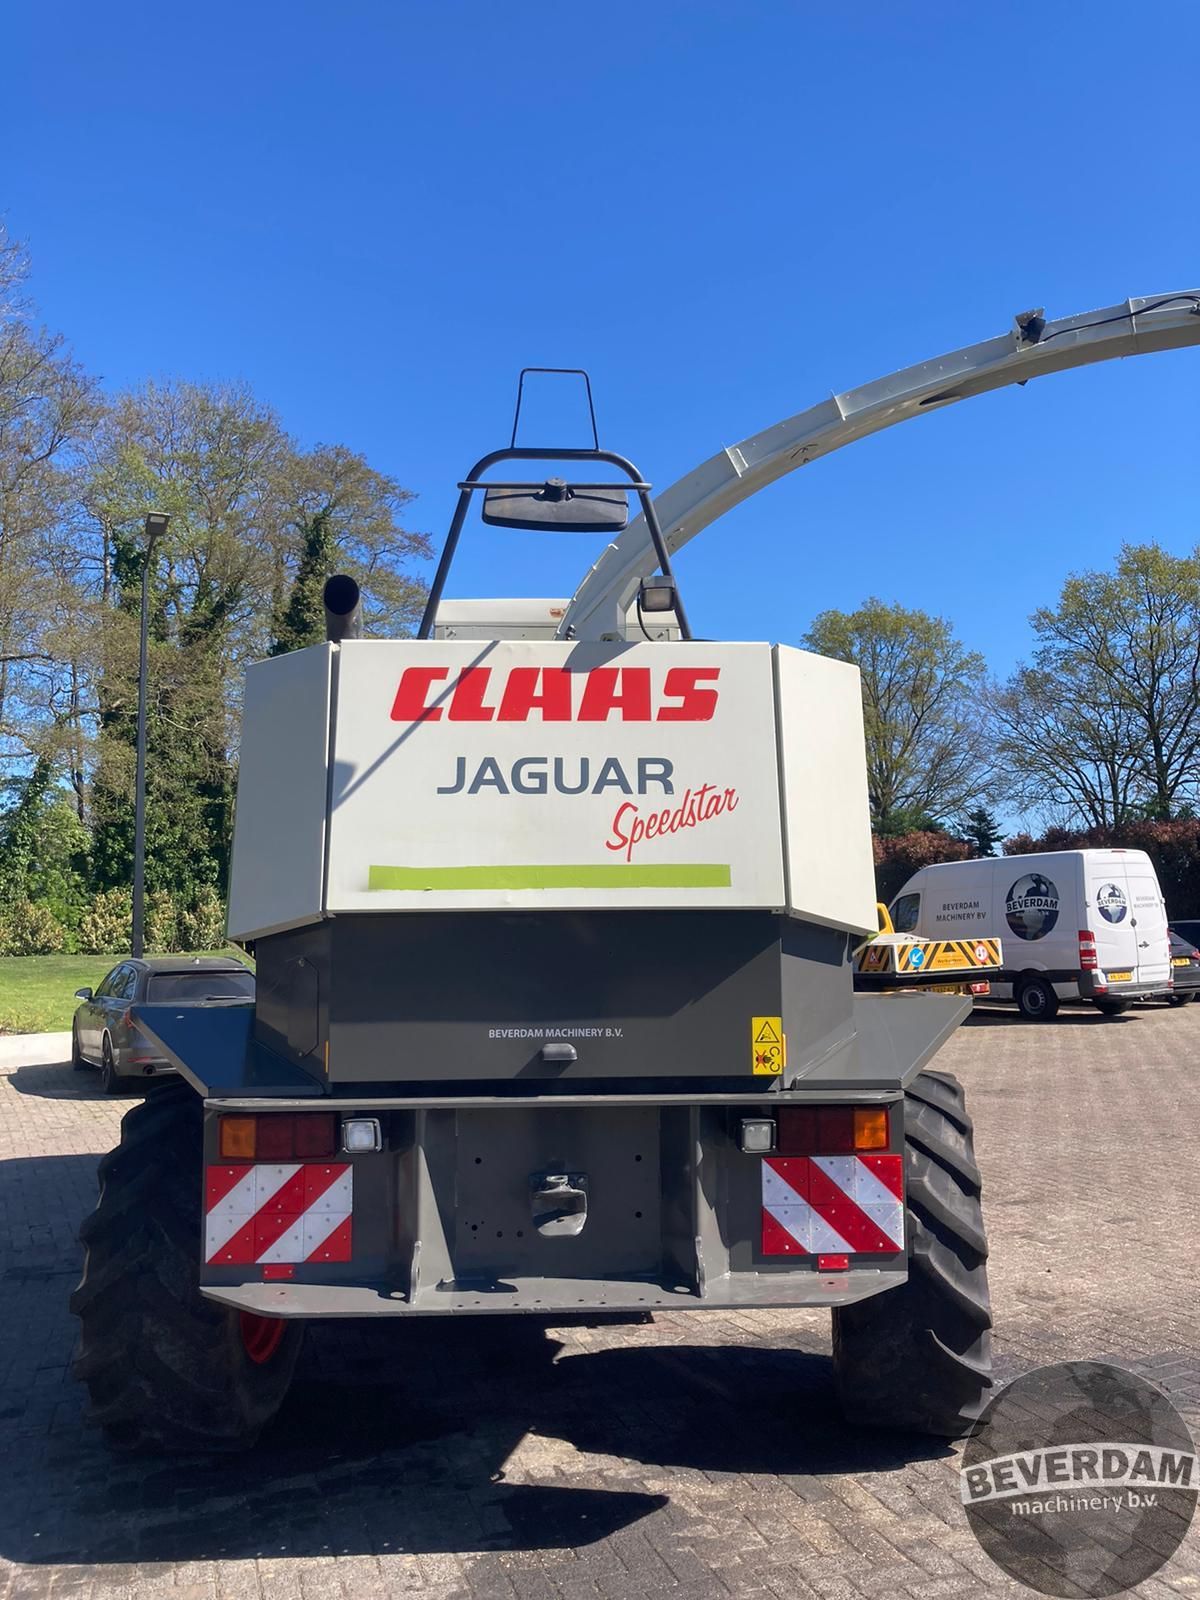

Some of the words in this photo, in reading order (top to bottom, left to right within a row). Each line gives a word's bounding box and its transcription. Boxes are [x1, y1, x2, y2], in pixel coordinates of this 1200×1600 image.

[390, 667, 721, 722] CLAAS
[437, 756, 675, 795] JAGUAR
[605, 783, 739, 863] Speedstar
[942, 901, 980, 911] BEVERDAM
[1006, 898, 1058, 912] BEVERDAM
[936, 912, 975, 922] MACHINERY
[976, 911, 987, 920] BV
[488, 1029, 544, 1039] BEVERDAM
[545, 1028, 603, 1038] MACHINERY
[605, 1028, 624, 1038] B.V.
